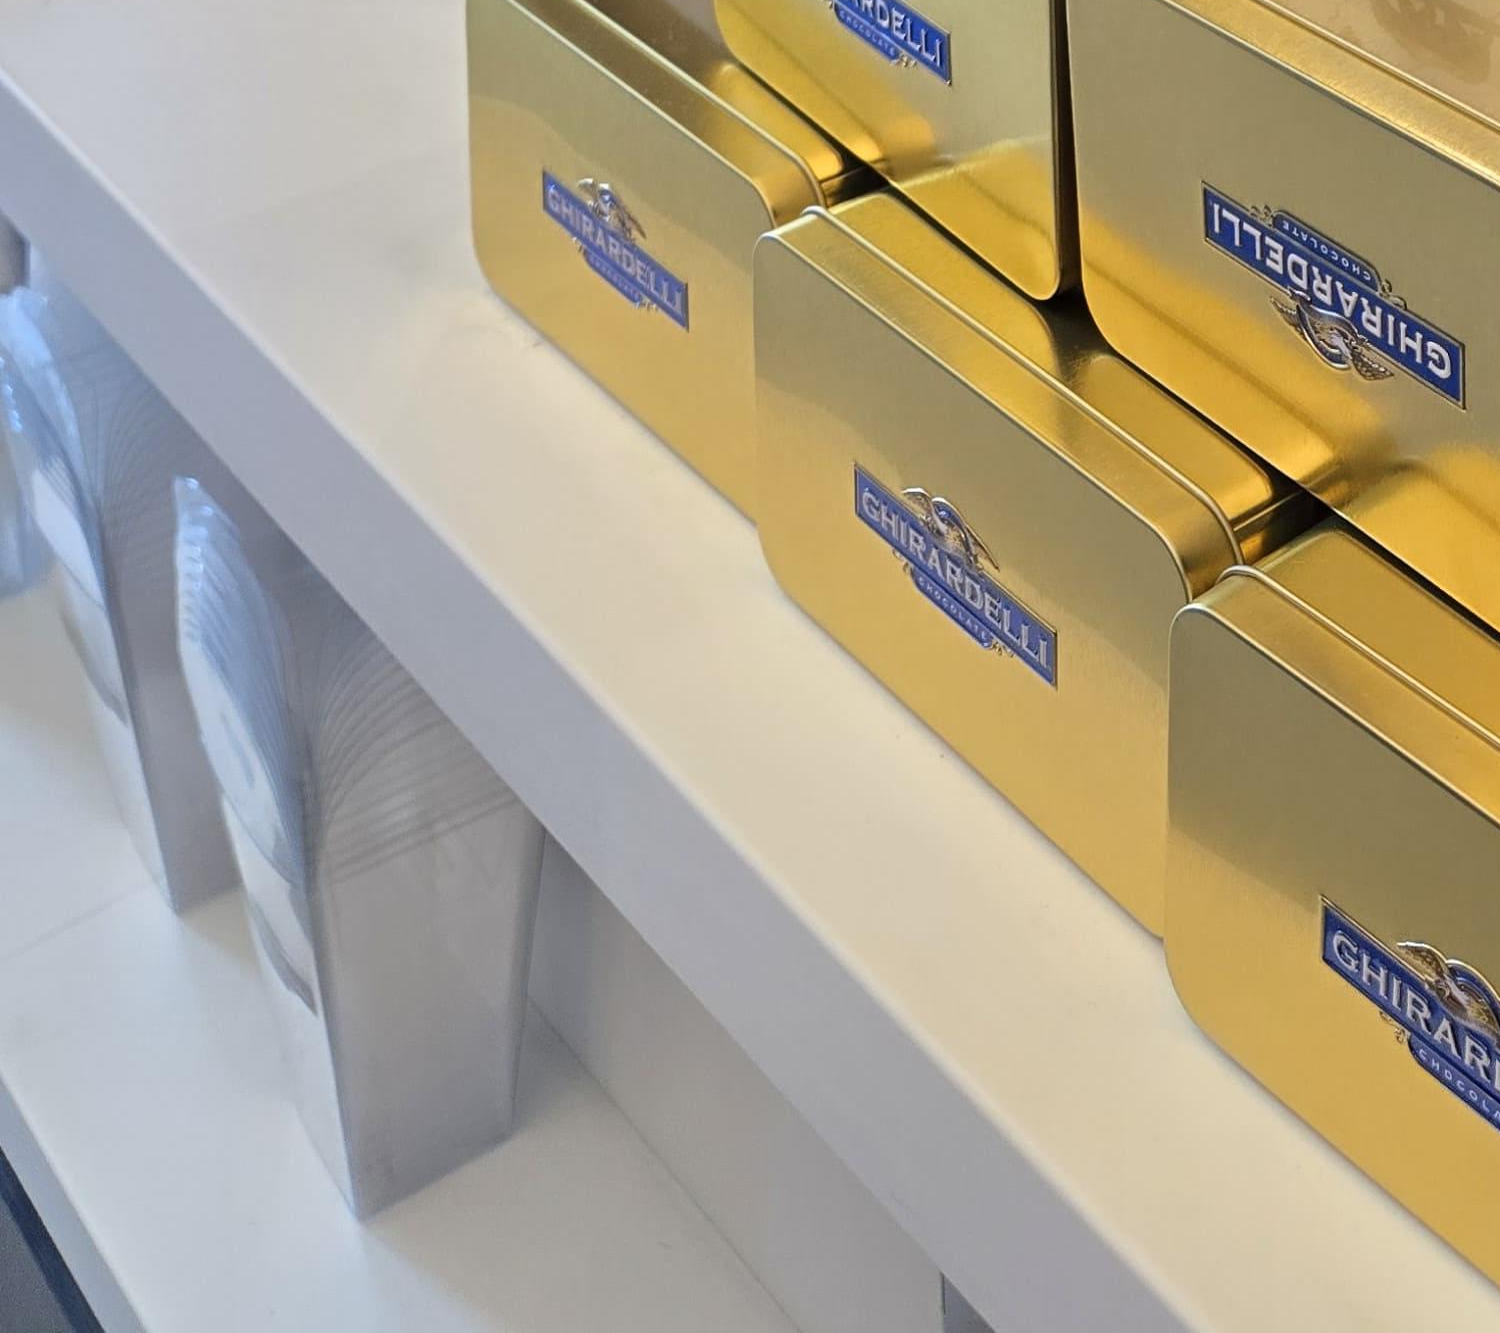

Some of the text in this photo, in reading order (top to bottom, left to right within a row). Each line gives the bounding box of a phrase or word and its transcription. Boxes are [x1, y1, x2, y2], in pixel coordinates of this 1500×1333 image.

[548, 184, 683, 316] GHIRARDELLI
[1212, 200, 1453, 382] GHIRARDELLI
[1282, 219, 1373, 283] CHOCOLATE
[862, 487, 1049, 670] GHIRARDELLI
